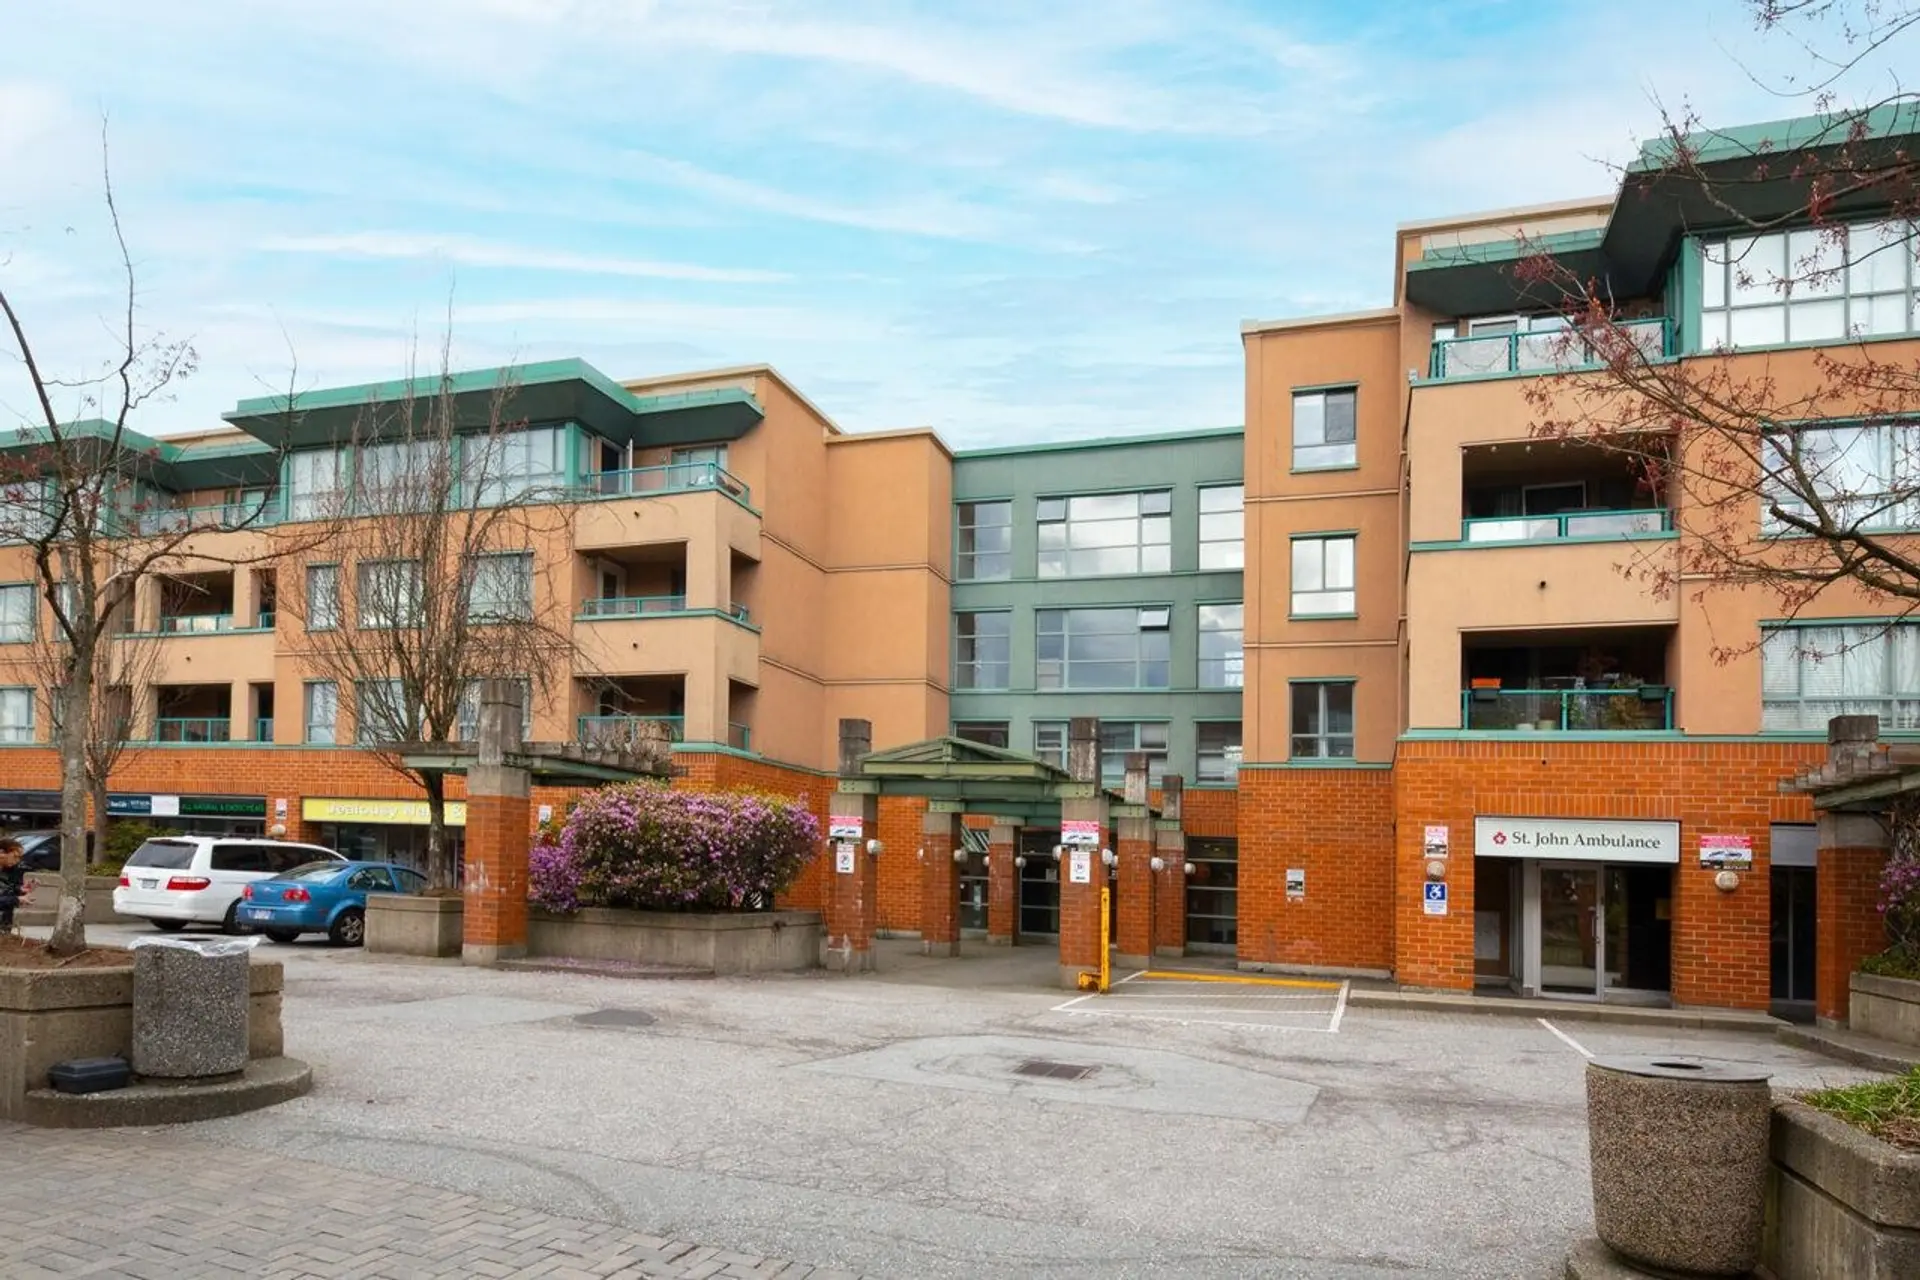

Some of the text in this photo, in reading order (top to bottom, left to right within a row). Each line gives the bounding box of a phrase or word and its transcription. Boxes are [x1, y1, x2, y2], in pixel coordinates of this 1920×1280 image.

[1512, 831, 1661, 849] St. John Ambulance
